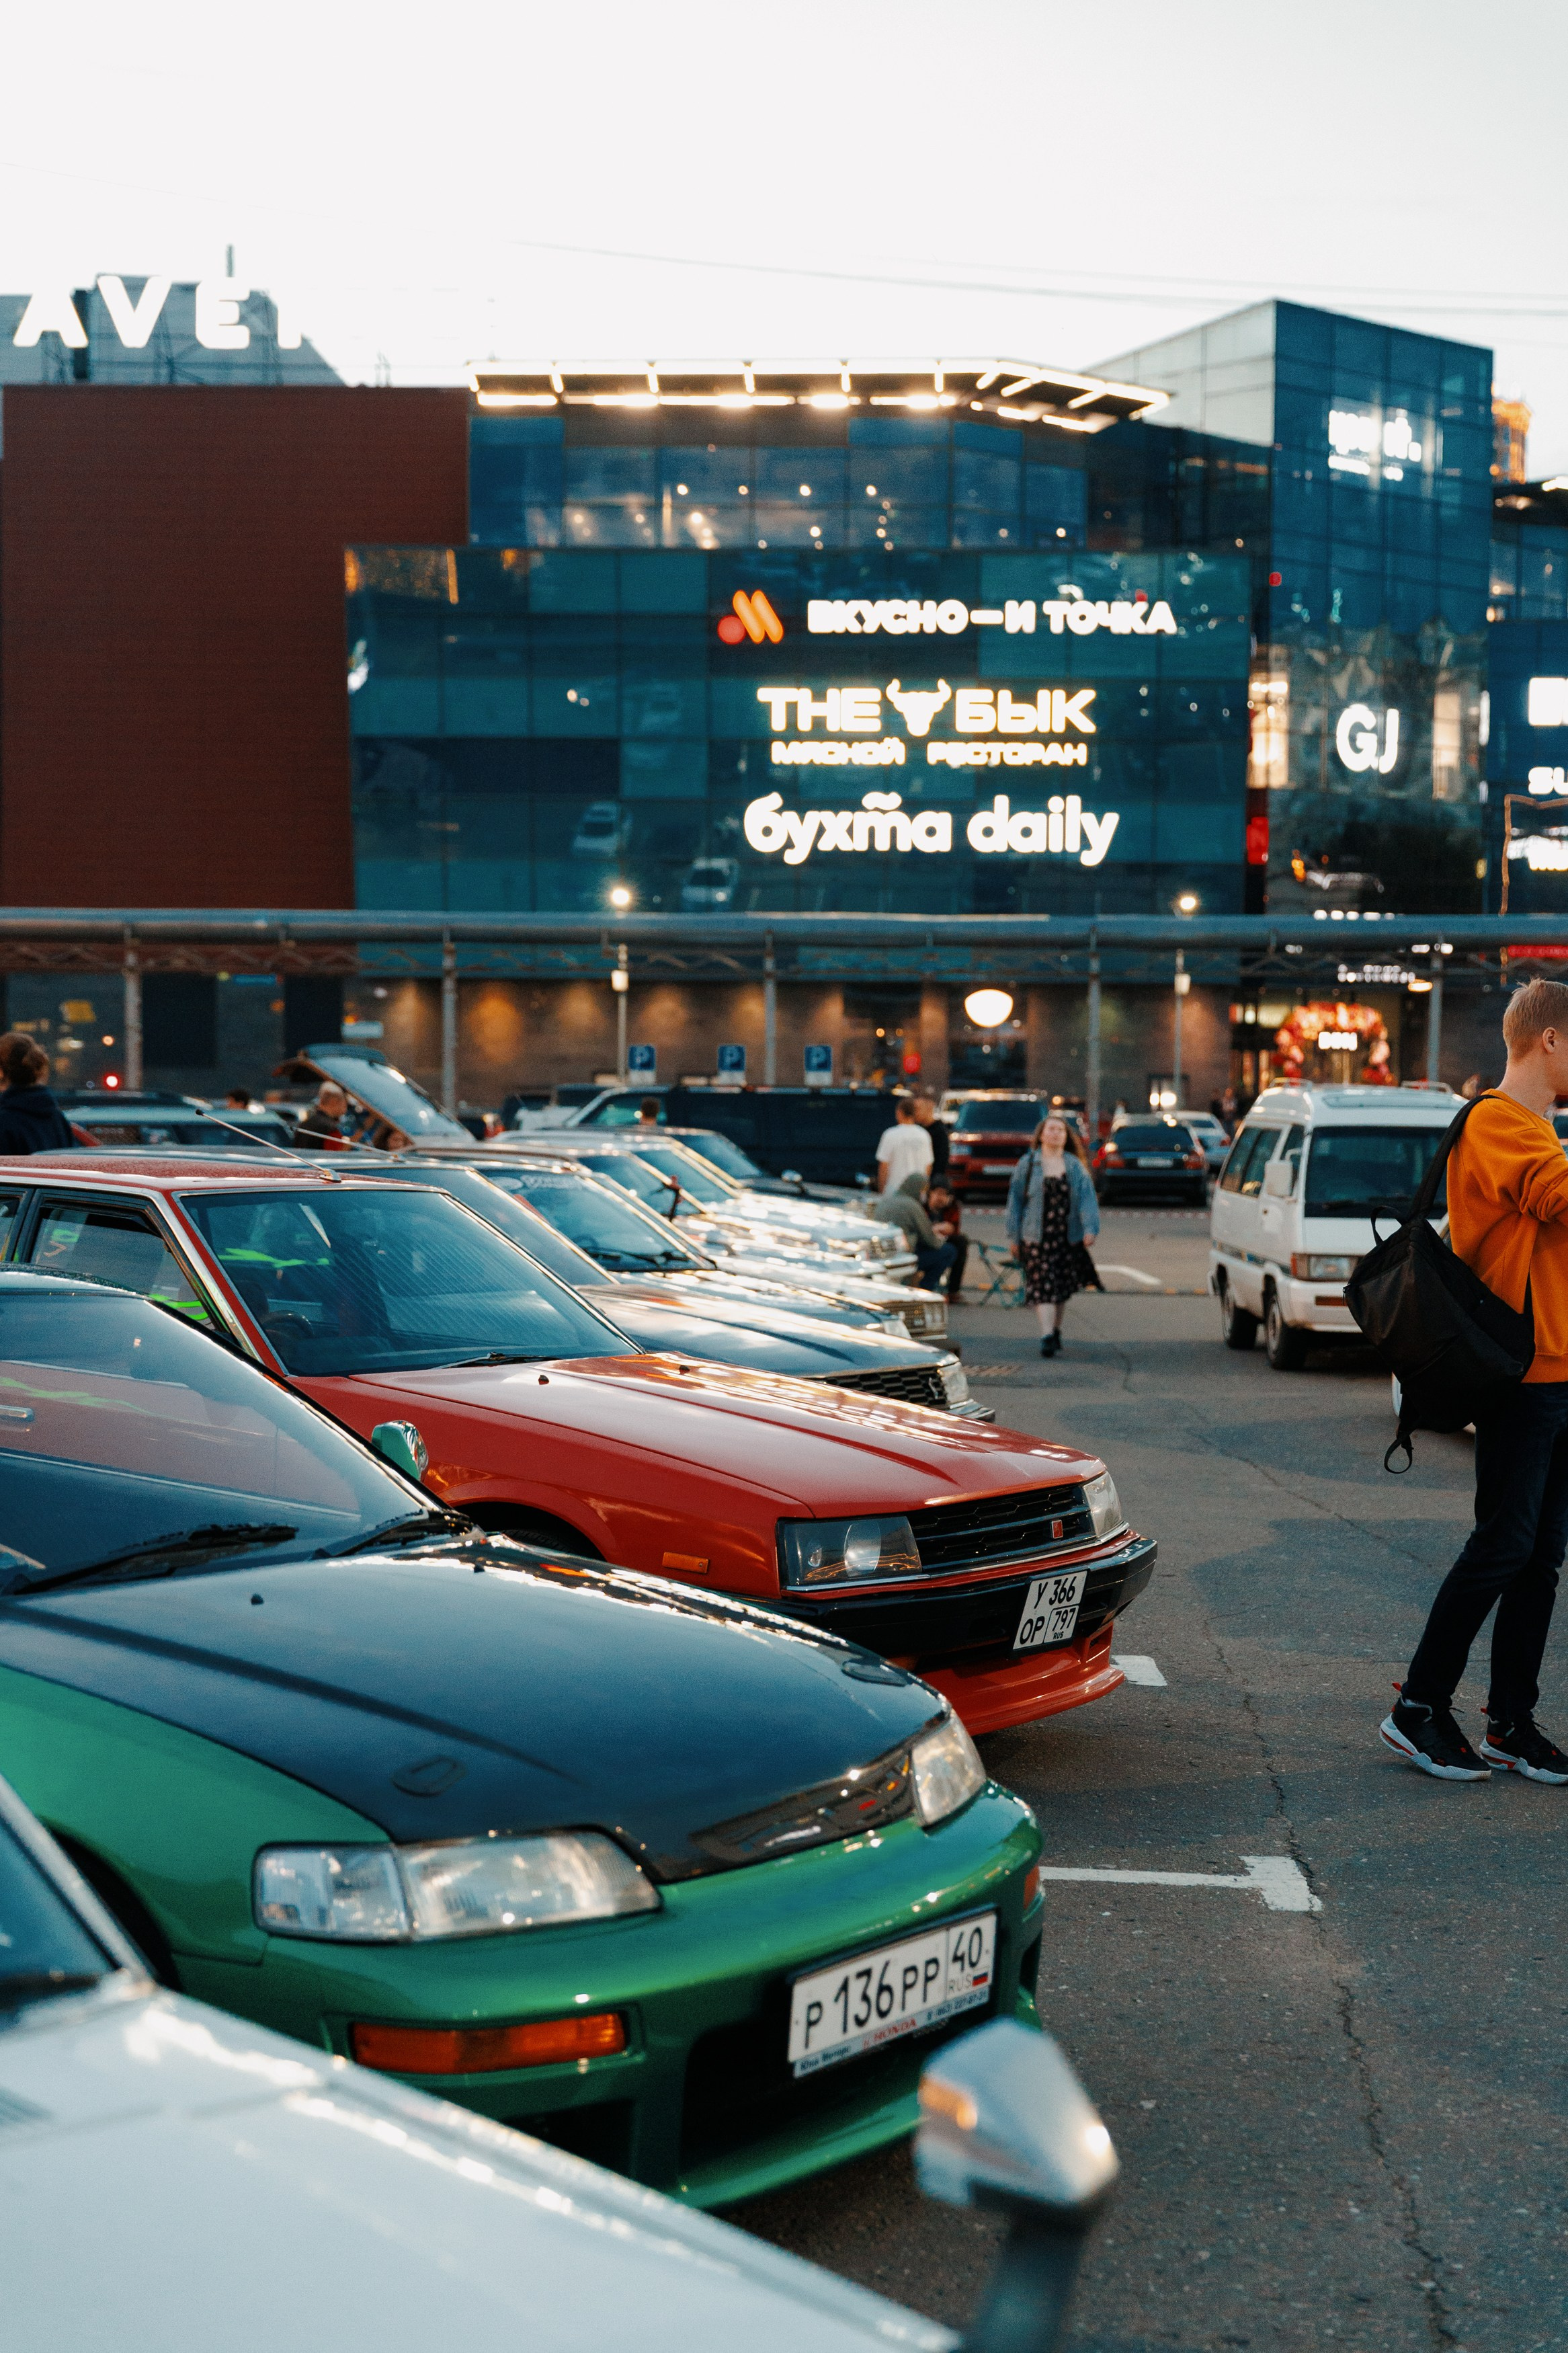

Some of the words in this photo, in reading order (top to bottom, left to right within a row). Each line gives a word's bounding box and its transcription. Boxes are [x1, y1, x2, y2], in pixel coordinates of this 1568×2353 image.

[1043, 600, 1178, 635] ТОЧКА
[757, 688, 882, 732] THE
[955, 689, 1096, 733] БЫК
[1335, 703, 1399, 774] GJ
[967, 795, 1120, 866] daily
[1049, 1576, 1077, 1605] 366
[1052, 1607, 1077, 1631] 797
[1053, 1631, 1064, 1640] RUS
[952, 1927, 983, 1972] 40
